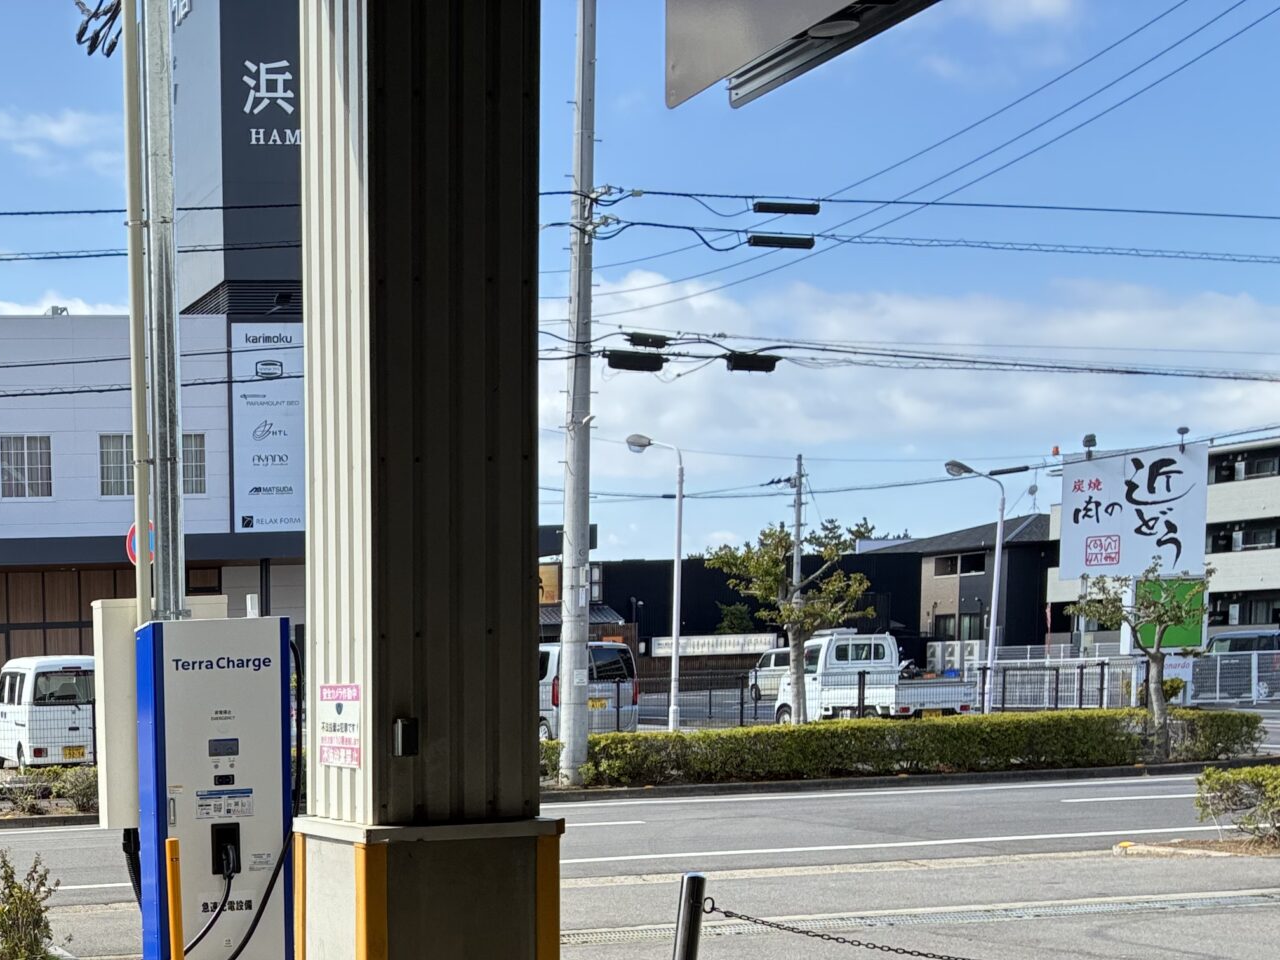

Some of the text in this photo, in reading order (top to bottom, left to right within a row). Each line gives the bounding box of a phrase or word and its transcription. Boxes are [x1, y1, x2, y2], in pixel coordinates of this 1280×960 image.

[242, 60, 294, 115] 浜
[245, 333, 292, 344] karimoku
[1072, 478, 1103, 493] 炭焼
[1073, 496, 1123, 525] 肉の
[280, 517, 301, 525] FORM
[172, 656, 272, 671] Terra Charge
